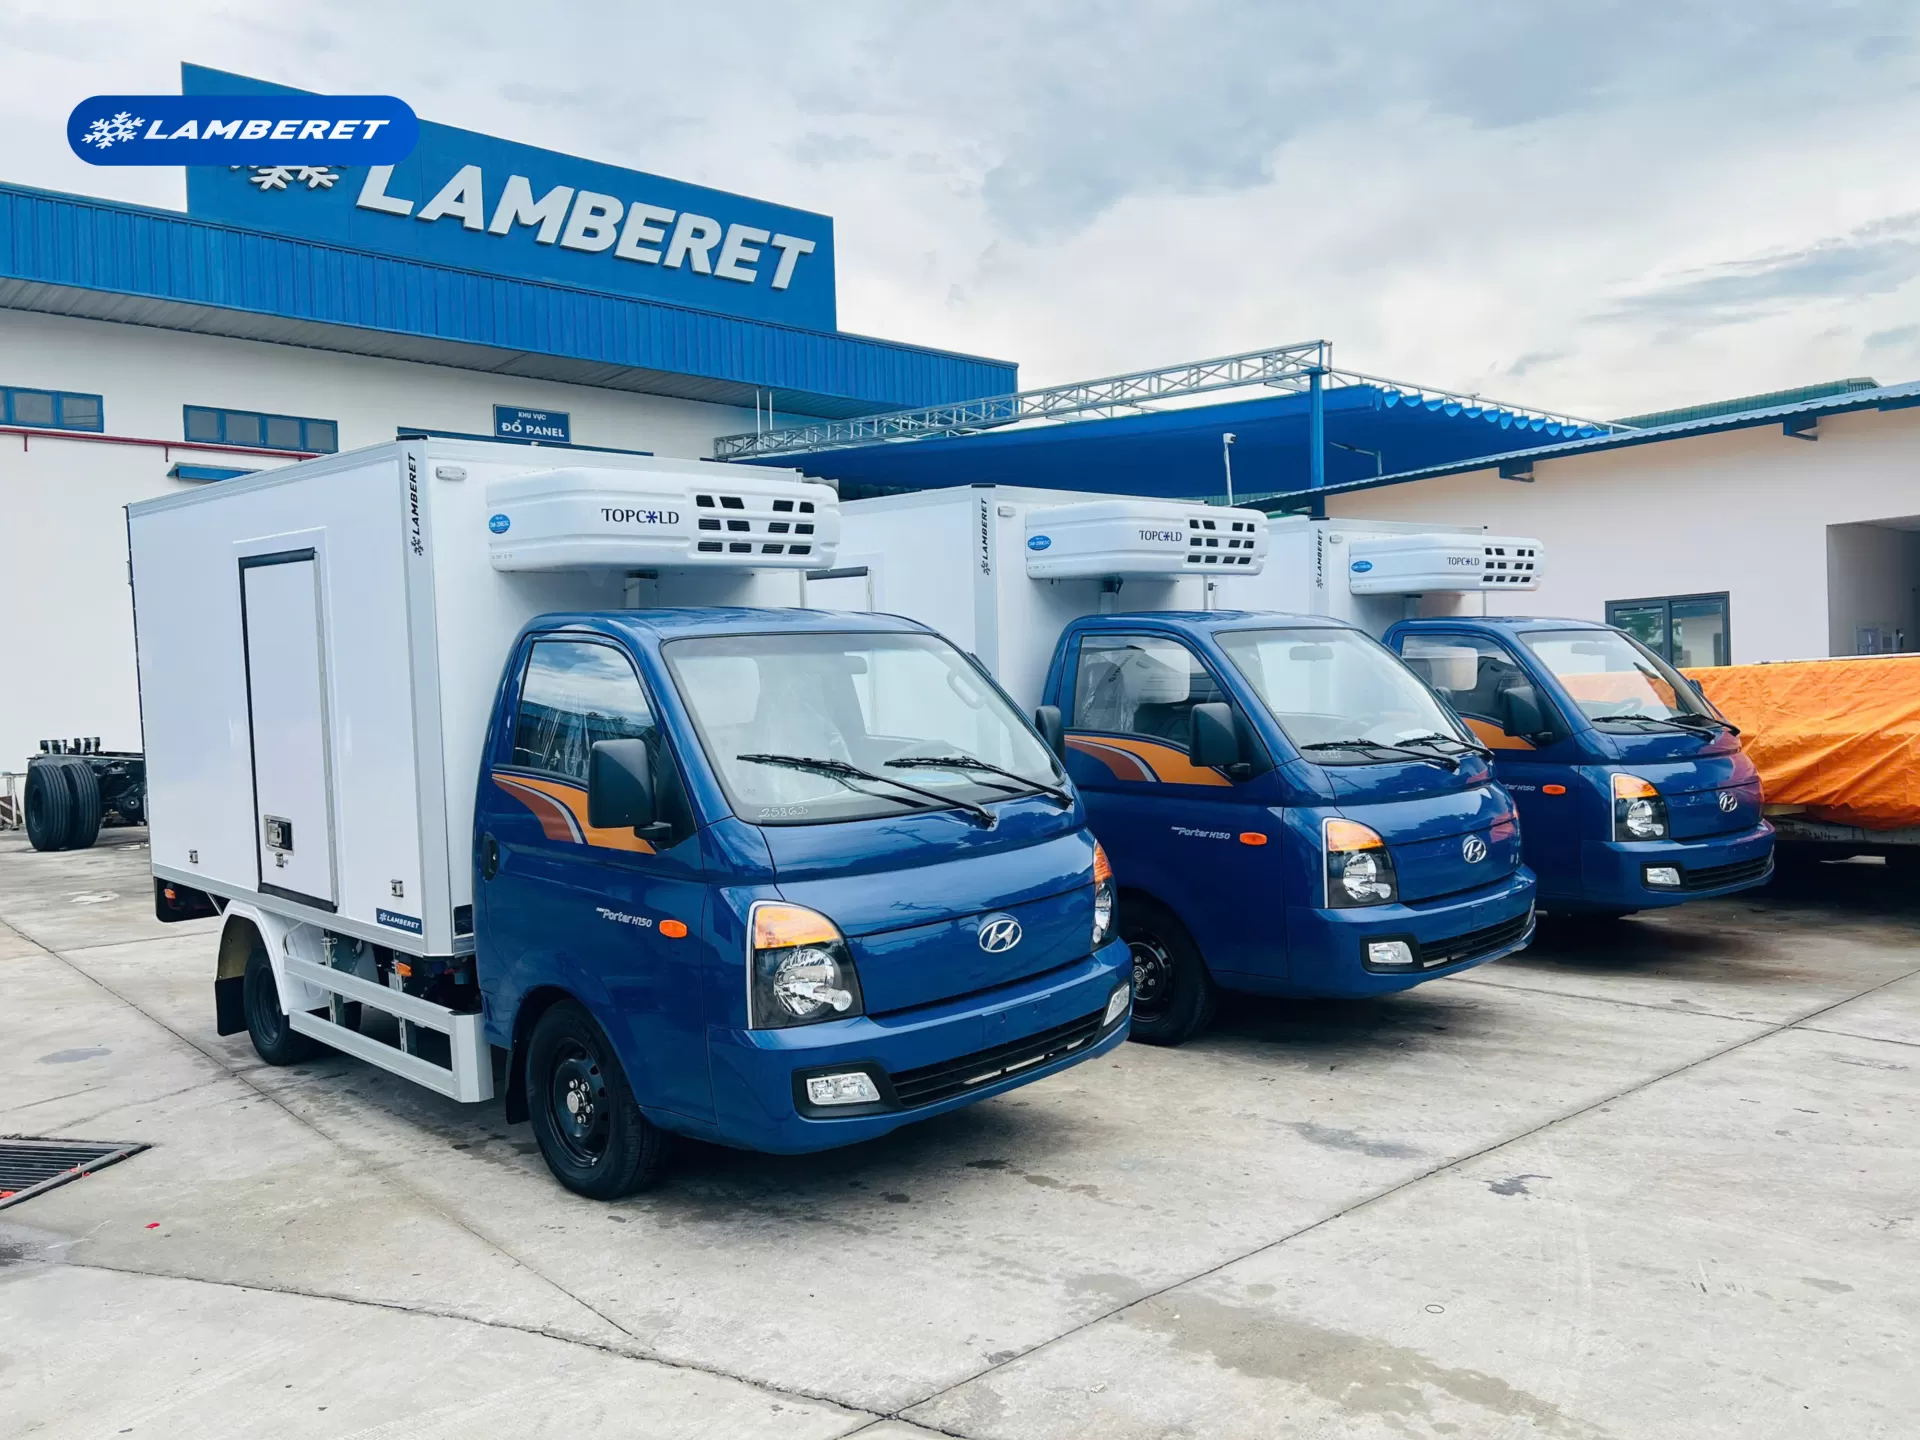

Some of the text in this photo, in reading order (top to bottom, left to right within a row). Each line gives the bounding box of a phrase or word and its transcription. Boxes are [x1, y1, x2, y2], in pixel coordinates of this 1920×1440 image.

[356, 164, 816, 290] LAMBERET
[518, 411, 532, 419] KHU
[501, 419, 565, 437] ĐỔ PANEL
[407, 452, 420, 536] LAMBERET
[1178, 827, 1209, 837] Porter
[1209, 831, 1231, 840] H150
[386, 915, 420, 929] LAMBERET
[602, 908, 632, 924] Porter
[631, 915, 653, 928] H150
